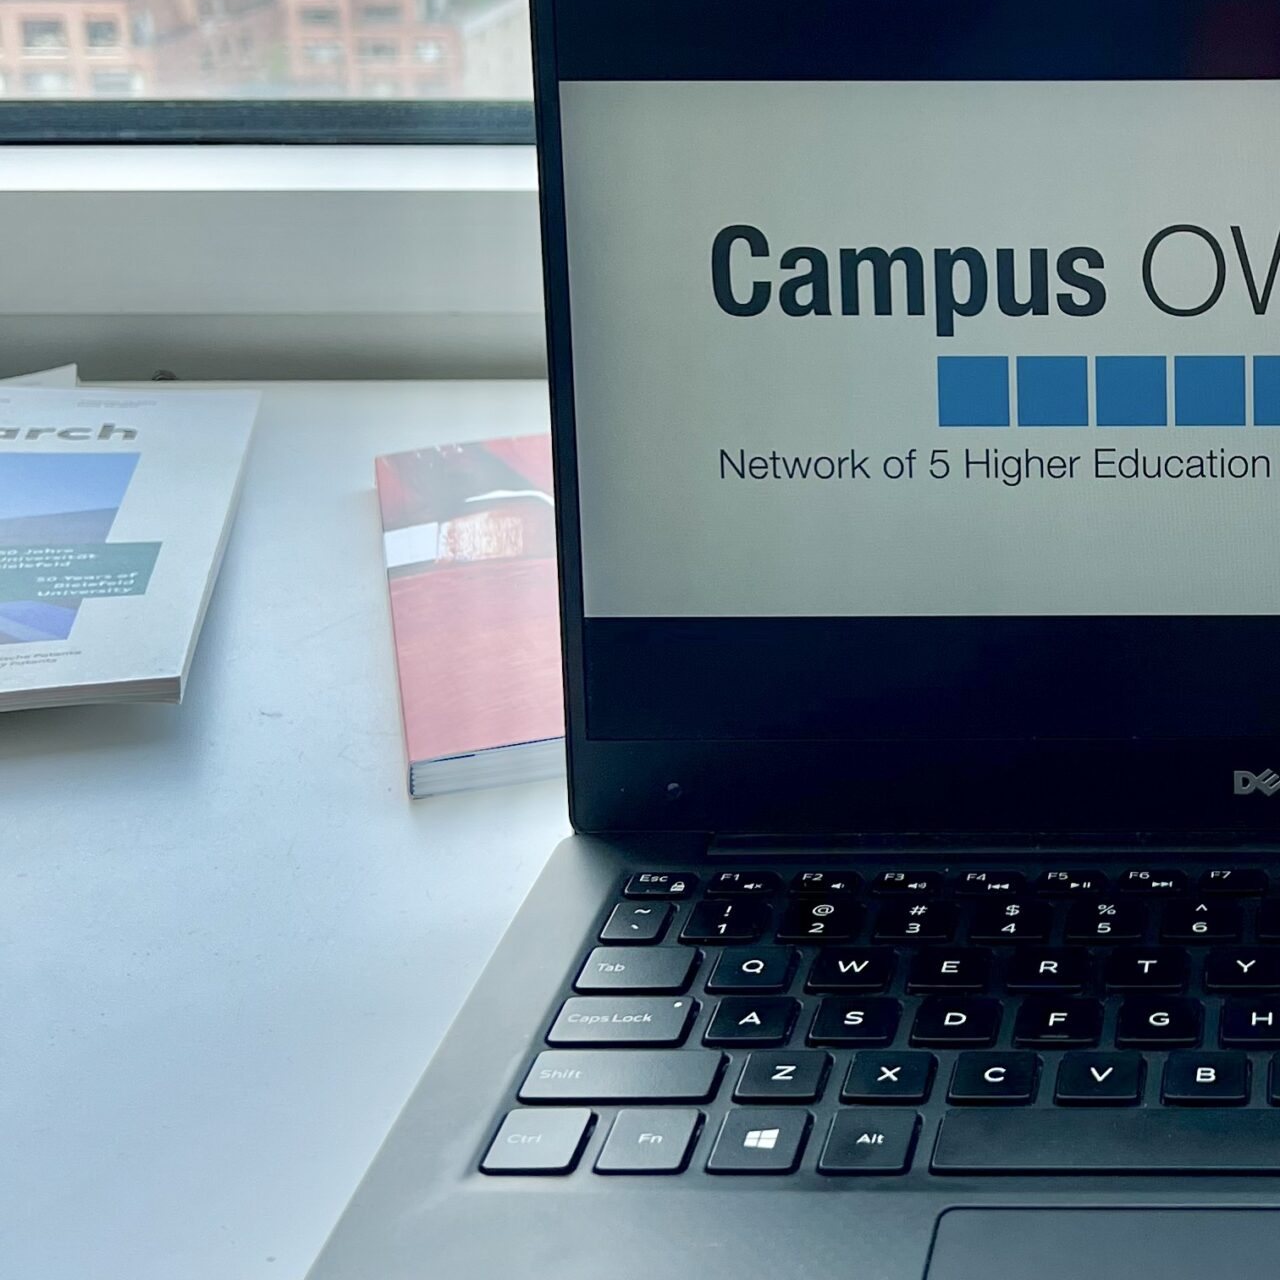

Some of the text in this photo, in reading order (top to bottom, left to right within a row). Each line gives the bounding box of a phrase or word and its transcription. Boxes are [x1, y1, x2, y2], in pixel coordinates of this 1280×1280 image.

[712, 224, 1106, 337] Campus
[720, 448, 870, 479] Network
[884, 448, 916, 479] of
[930, 449, 949, 479] 5
[965, 448, 1080, 486] Higher
[1094, 448, 1270, 479] Education
[640, 874, 668, 882] Esc
[720, 873, 739, 881] F1
[802, 873, 823, 881] F2
[884, 873, 904, 881] F3
[966, 873, 986, 881] F4
[1048, 872, 1068, 880] F5
[1211, 871, 1231, 879] F7
[812, 905, 834, 916] @
[909, 906, 927, 915] #
[1006, 904, 1020, 916] $
[1098, 905, 1116, 915] %
[718, 924, 727, 933] 1
[808, 923, 824, 933] 2
[906, 923, 920, 933] 3
[1001, 923, 1016, 933] 4
[1097, 923, 1111, 933] 5
[1192, 922, 1208, 932] 6
[596, 963, 625, 973] Tab
[742, 960, 764, 974] Q
[838, 961, 869, 972] W
[942, 961, 960, 973] E
[1039, 961, 1058, 973] R
[1138, 960, 1157, 973] T
[1236, 960, 1256, 972] Y
[566, 1012, 652, 1025] Caps Lock
[739, 1012, 761, 1025] A
[844, 1012, 864, 1025] S
[944, 1013, 967, 1025] D
[1049, 1013, 1067, 1026] F
[1149, 1013, 1169, 1026] G
[1252, 1012, 1272, 1025] H
[540, 1069, 583, 1079] Shift
[771, 1066, 796, 1080] Z
[878, 1067, 900, 1081] X
[984, 1068, 1006, 1082] C
[1091, 1067, 1113, 1081] V
[1196, 1068, 1215, 1082] B
[507, 1134, 542, 1144] Ctrl
[639, 1134, 662, 1144] Fn
[857, 1134, 884, 1145] Alt
